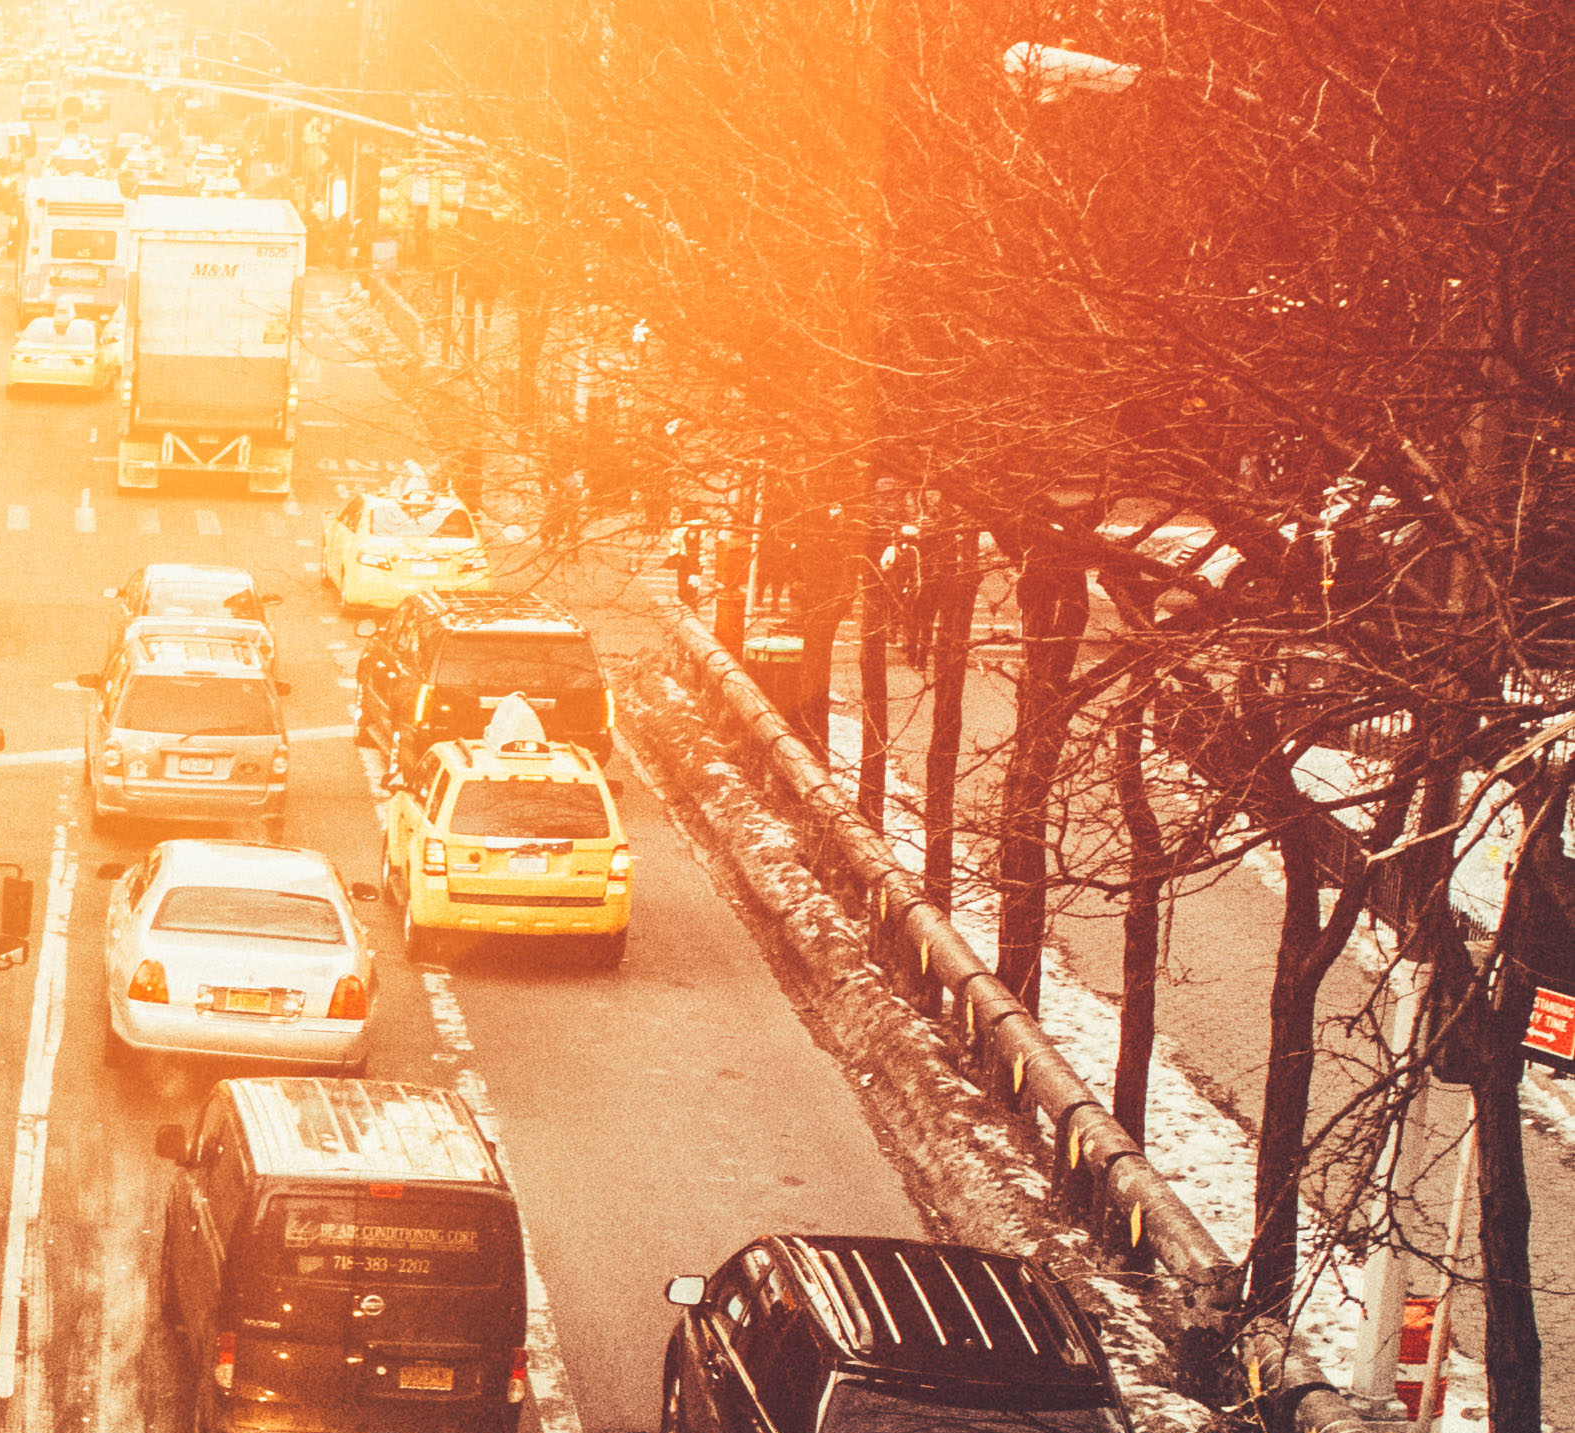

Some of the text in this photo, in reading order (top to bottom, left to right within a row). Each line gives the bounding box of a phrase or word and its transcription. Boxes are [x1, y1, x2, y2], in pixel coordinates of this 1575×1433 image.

[191, 263, 239, 278] M&M
[1546, 1015, 1568, 1033] TIME
[362, 1226, 445, 1243] CONDITIONING
